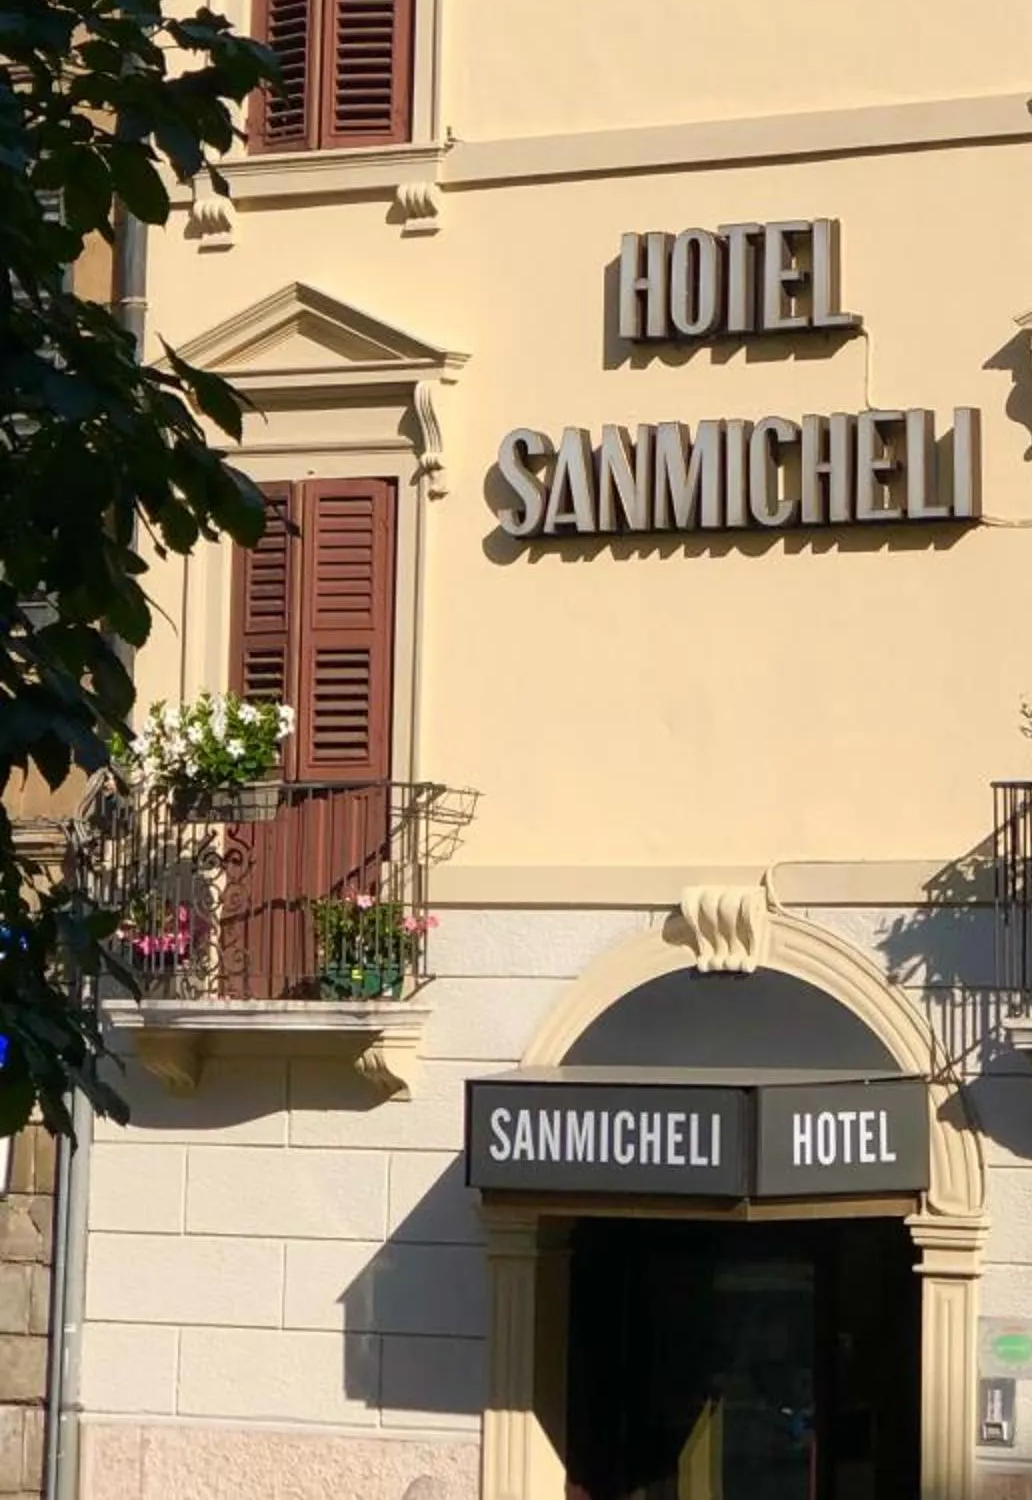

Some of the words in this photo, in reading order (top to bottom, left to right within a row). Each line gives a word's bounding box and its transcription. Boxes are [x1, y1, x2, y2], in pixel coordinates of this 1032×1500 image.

[619, 218, 859, 339] HOTEL
[498, 407, 981, 536] SANMICHELI
[489, 1107, 721, 1167] SANMICHELI
[792, 1110, 896, 1165] HOTEL
